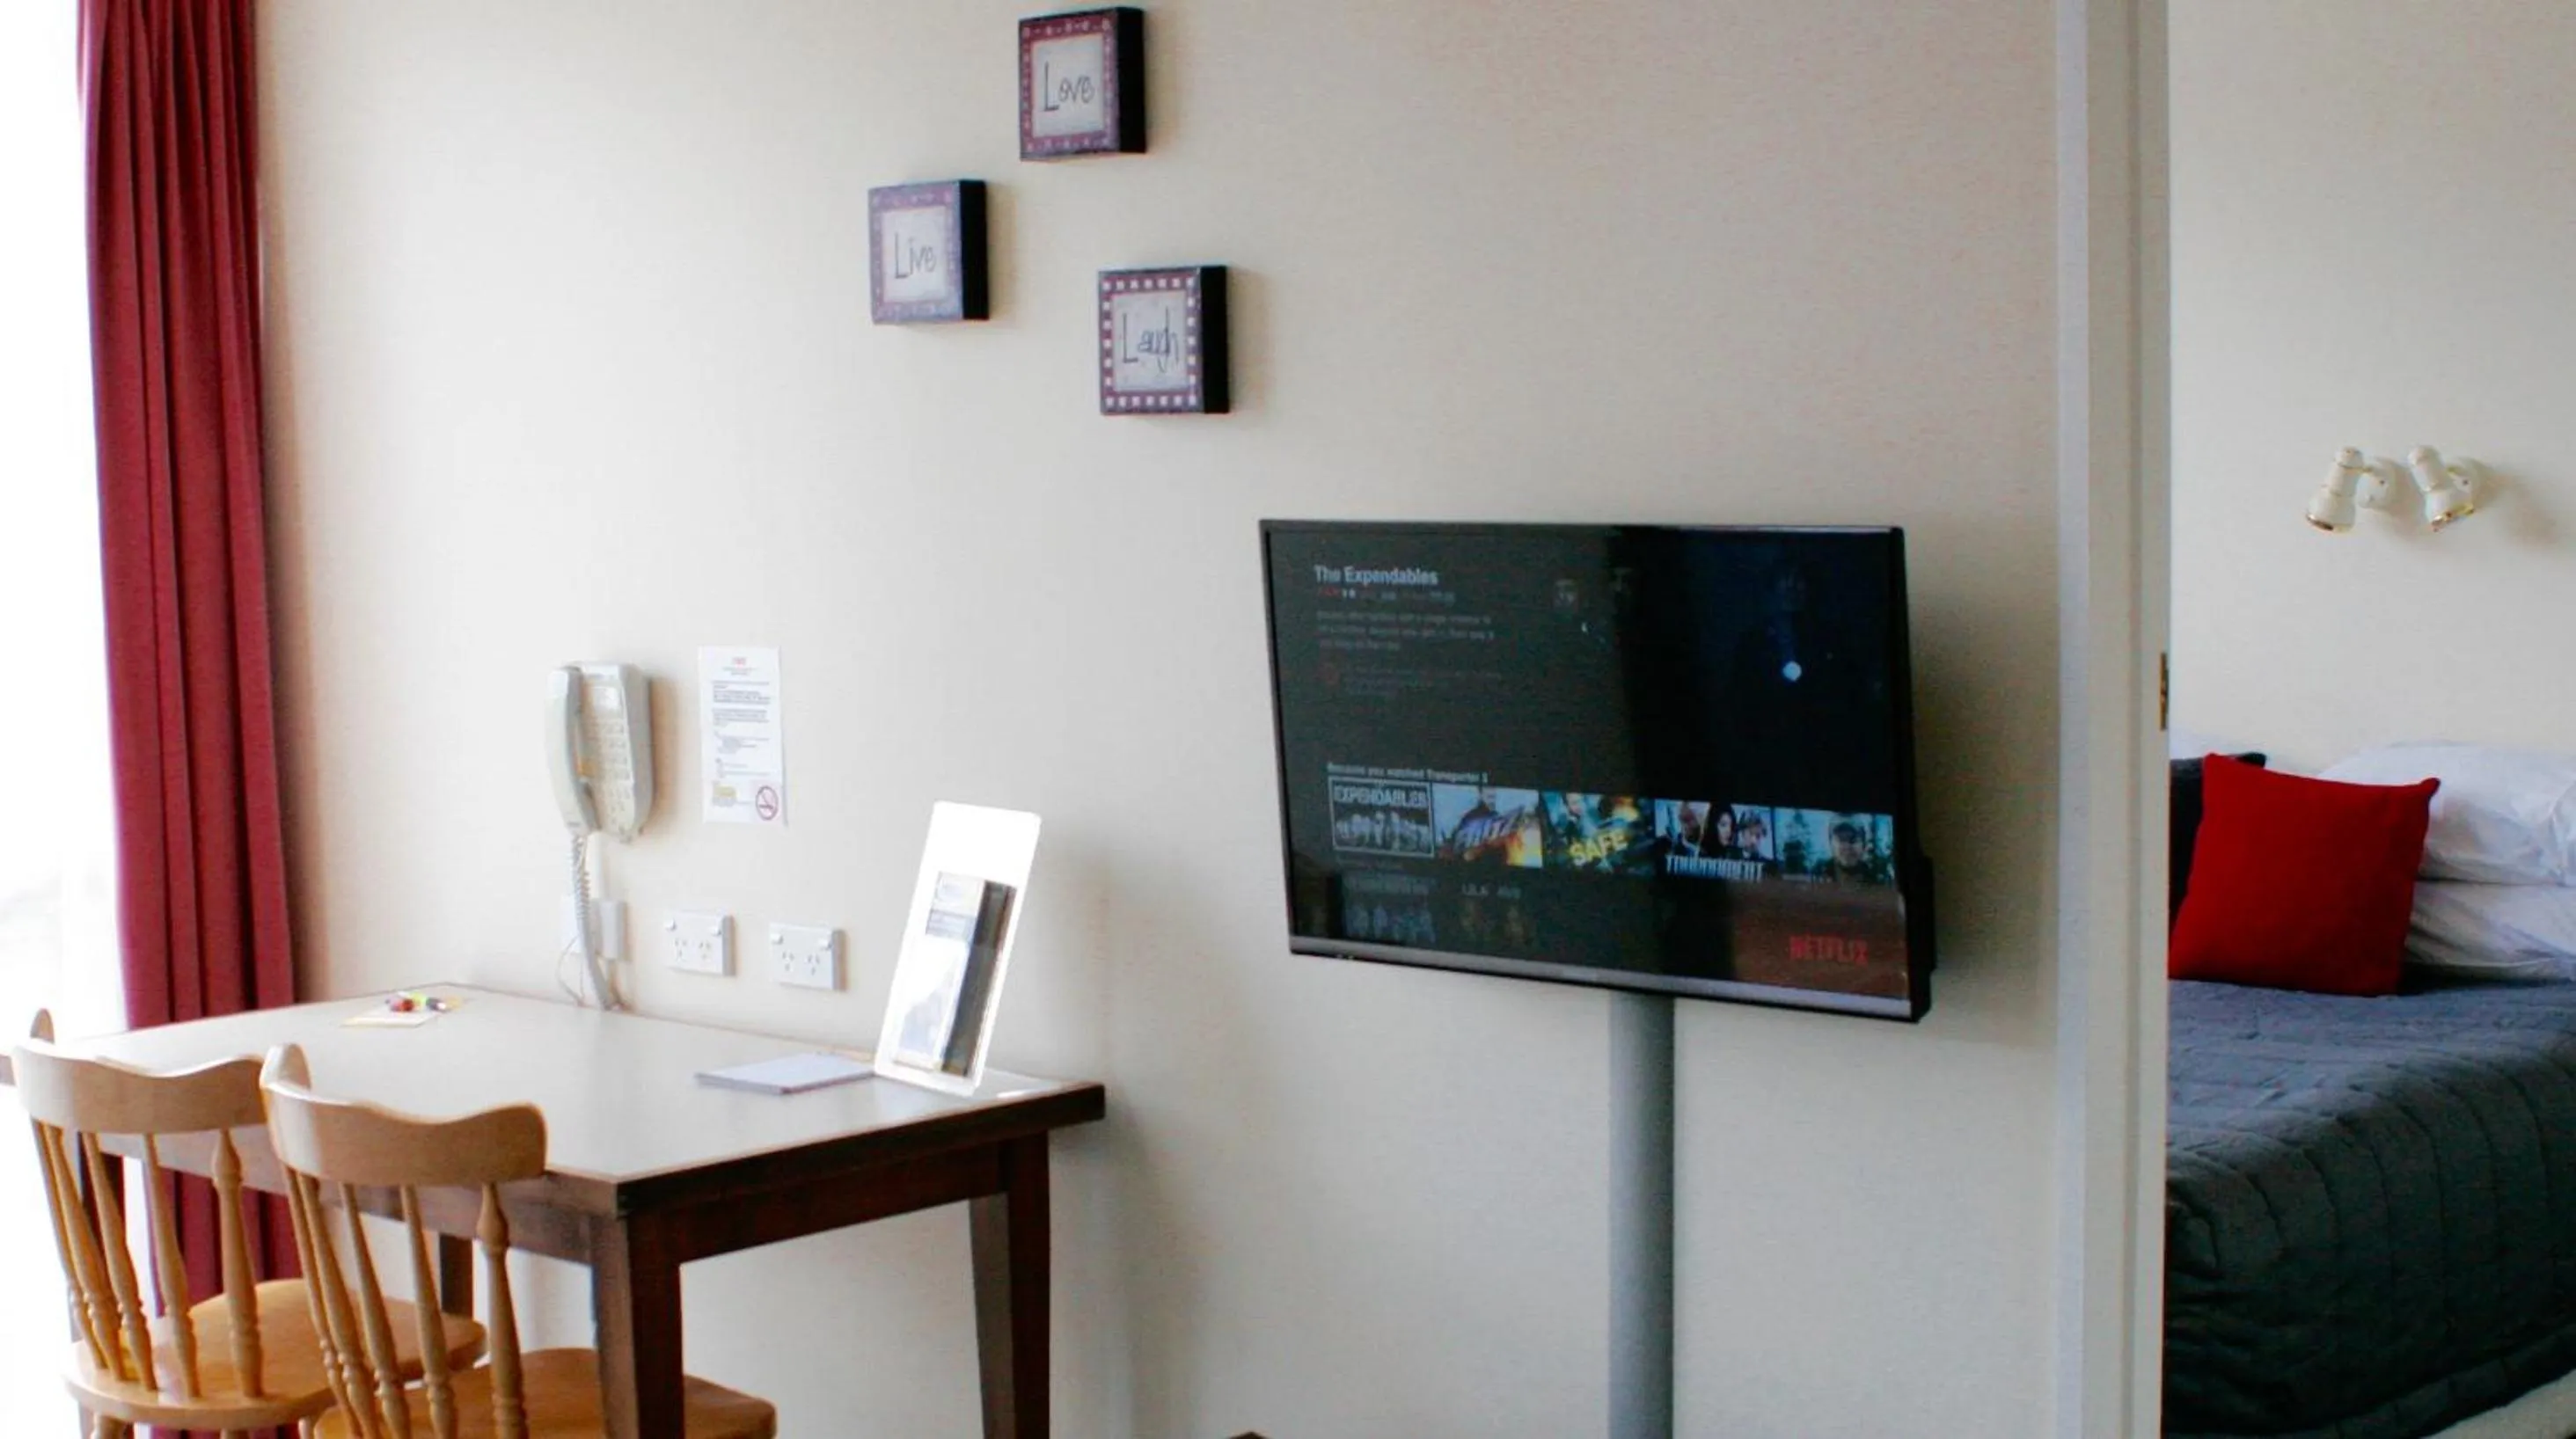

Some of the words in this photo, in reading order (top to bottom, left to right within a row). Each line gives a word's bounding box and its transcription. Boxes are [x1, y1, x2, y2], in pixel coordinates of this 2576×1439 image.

[1043, 62, 1094, 113] Love
[895, 233, 937, 279] Live
[1122, 307, 1180, 373] Laugh
[1314, 564, 1341, 584] The
[1343, 566, 1439, 587] Expendables
[1569, 829, 1628, 865] SAFE
[1789, 934, 1869, 965] NETFLIX
